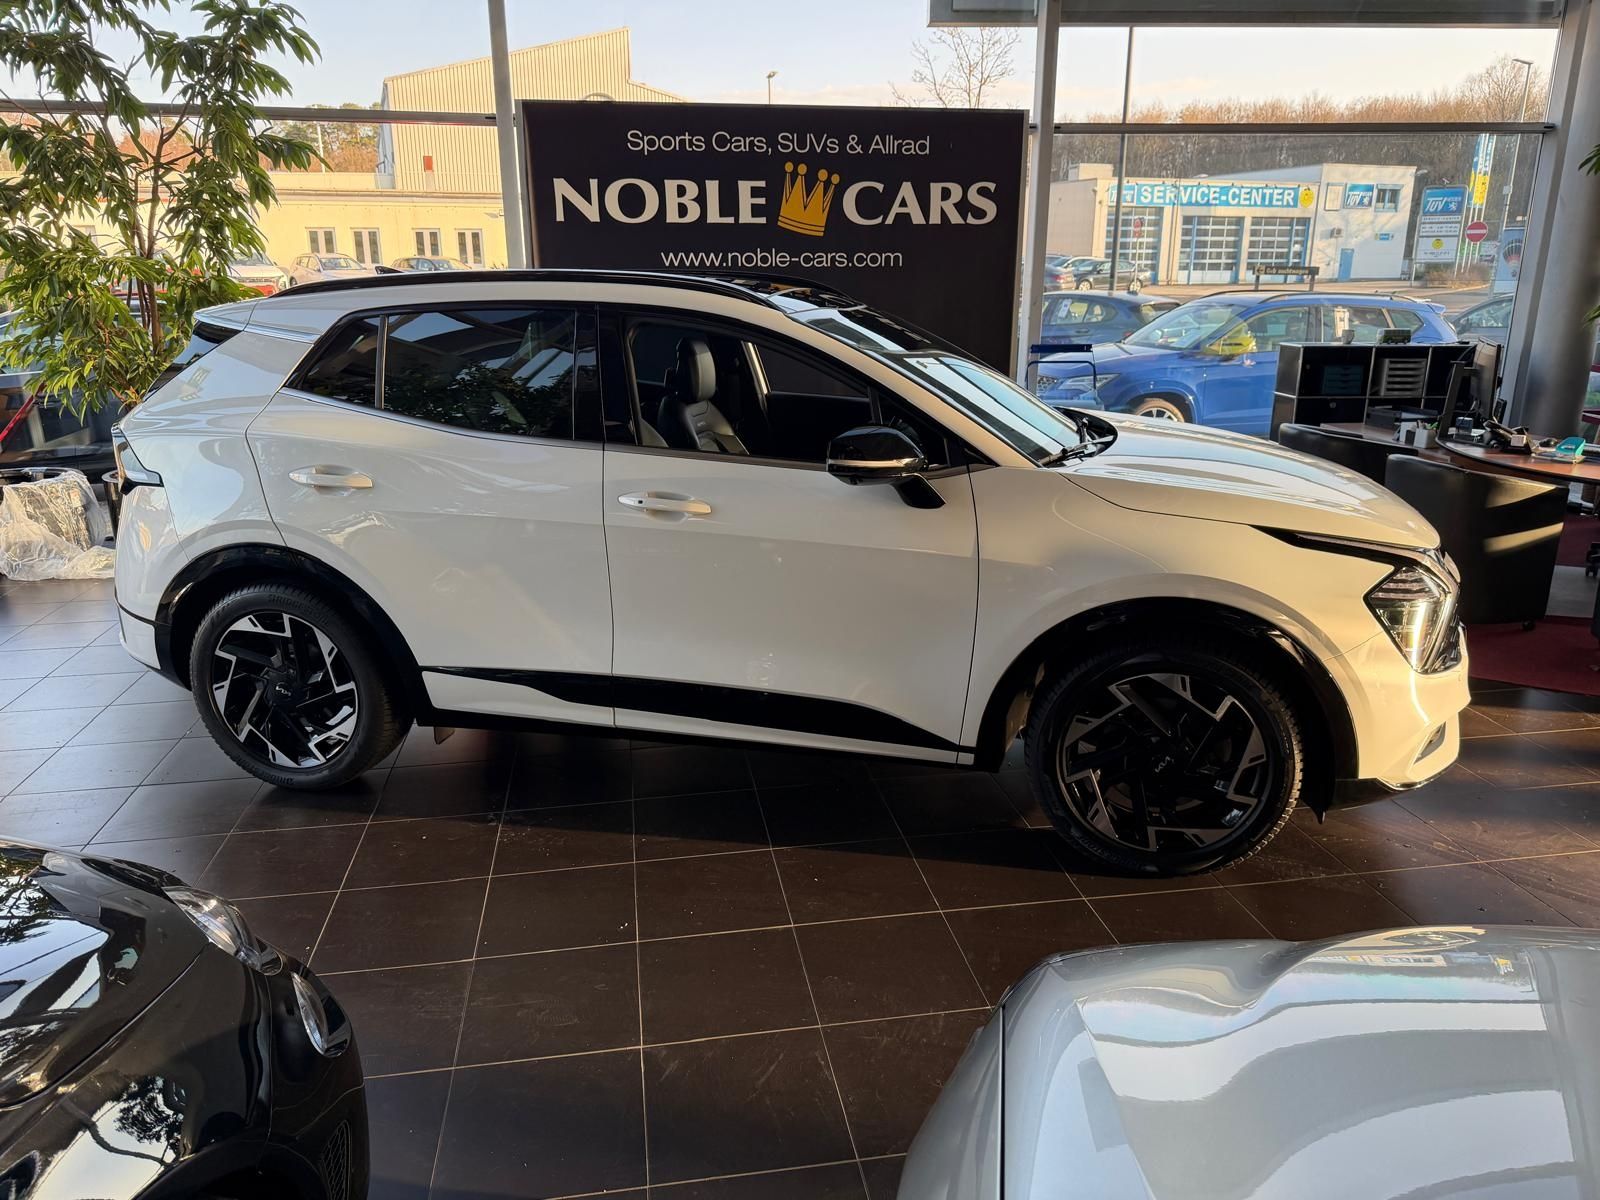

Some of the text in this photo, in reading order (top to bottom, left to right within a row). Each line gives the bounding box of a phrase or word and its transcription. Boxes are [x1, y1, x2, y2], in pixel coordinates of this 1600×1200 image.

[626, 129, 931, 156] Sports Cars, SUVs & Allrad
[552, 177, 997, 226] NOBLE CARS
[1140, 185, 1295, 206] SERVICE-CENTER
[660, 247, 903, 268] www.noble-cars.com
